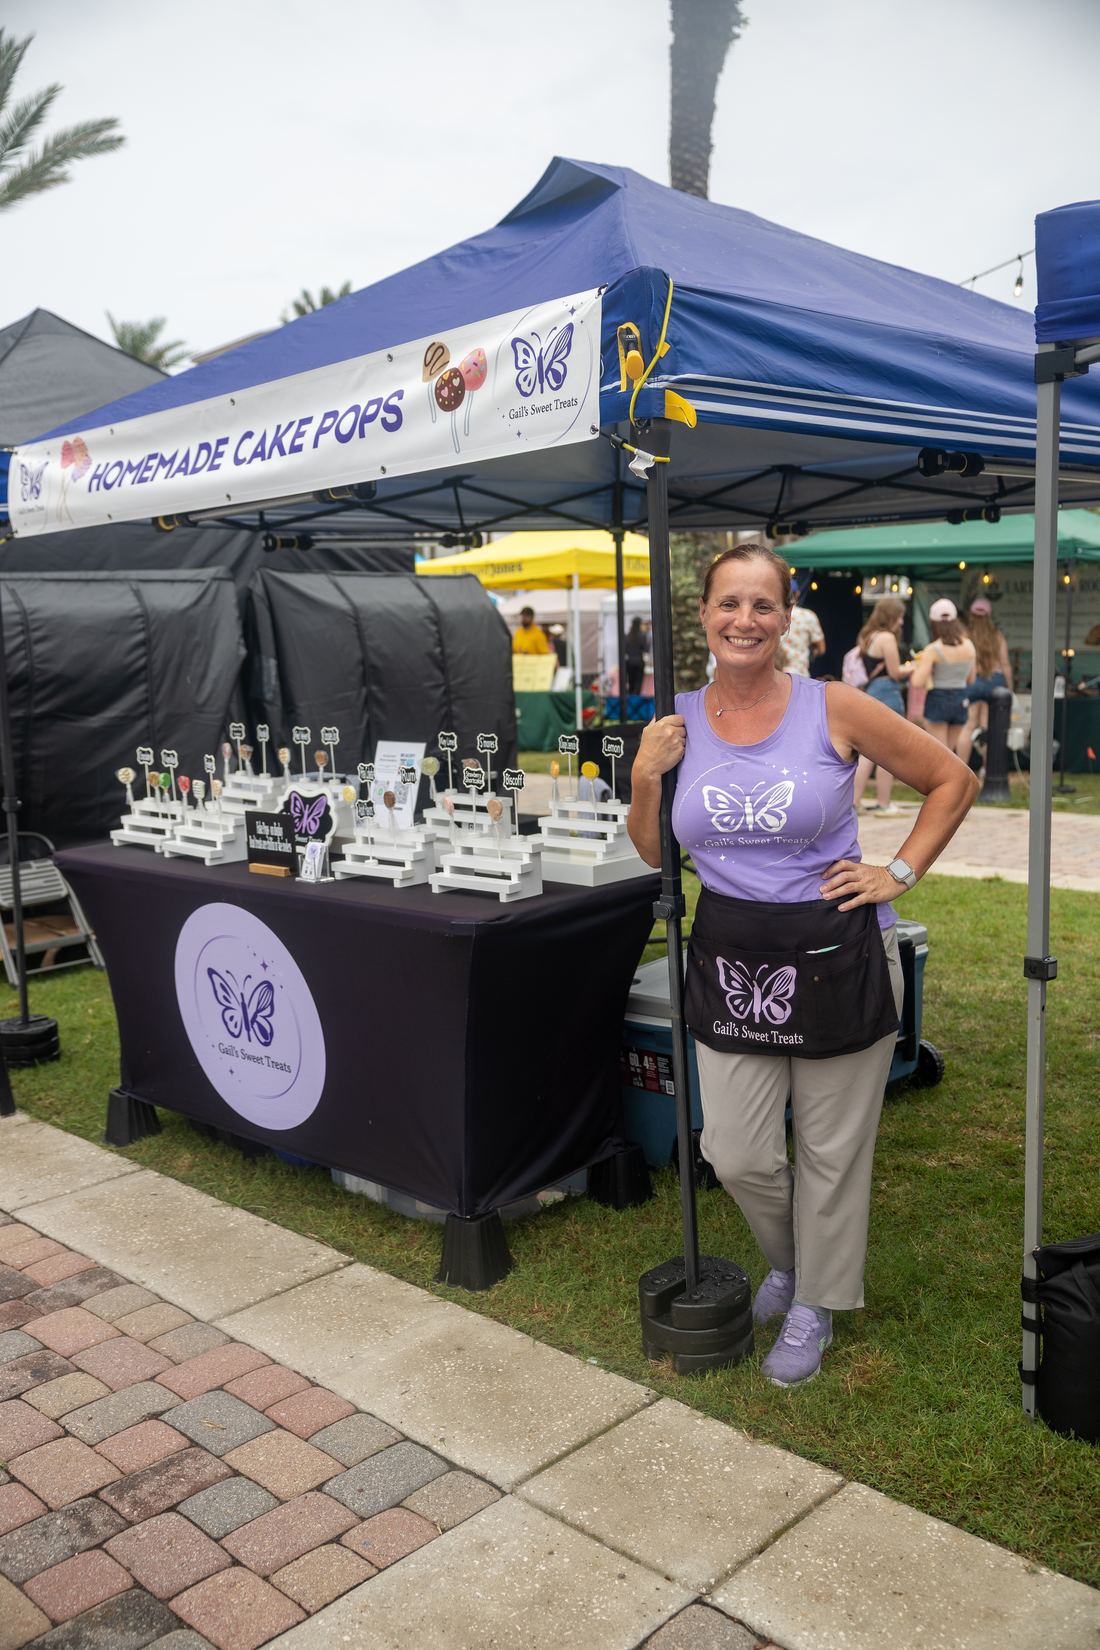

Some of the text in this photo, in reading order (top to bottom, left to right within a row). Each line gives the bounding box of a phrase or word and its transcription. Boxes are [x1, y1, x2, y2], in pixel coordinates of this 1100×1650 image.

[508, 396, 579, 420] Gail's Sweet Treats
[87, 389, 405, 493] HOMEMADE CAKE POPS
[604, 740, 620, 753] Lemon
[401, 769, 416, 783] Rum
[505, 773, 523, 786] Biscoff
[704, 836, 809, 848] Gail's Sweet Treats
[713, 1020, 804, 1045] Gail's Sweet Treats
[218, 1042, 292, 1073] Gail's Sweet Treats
